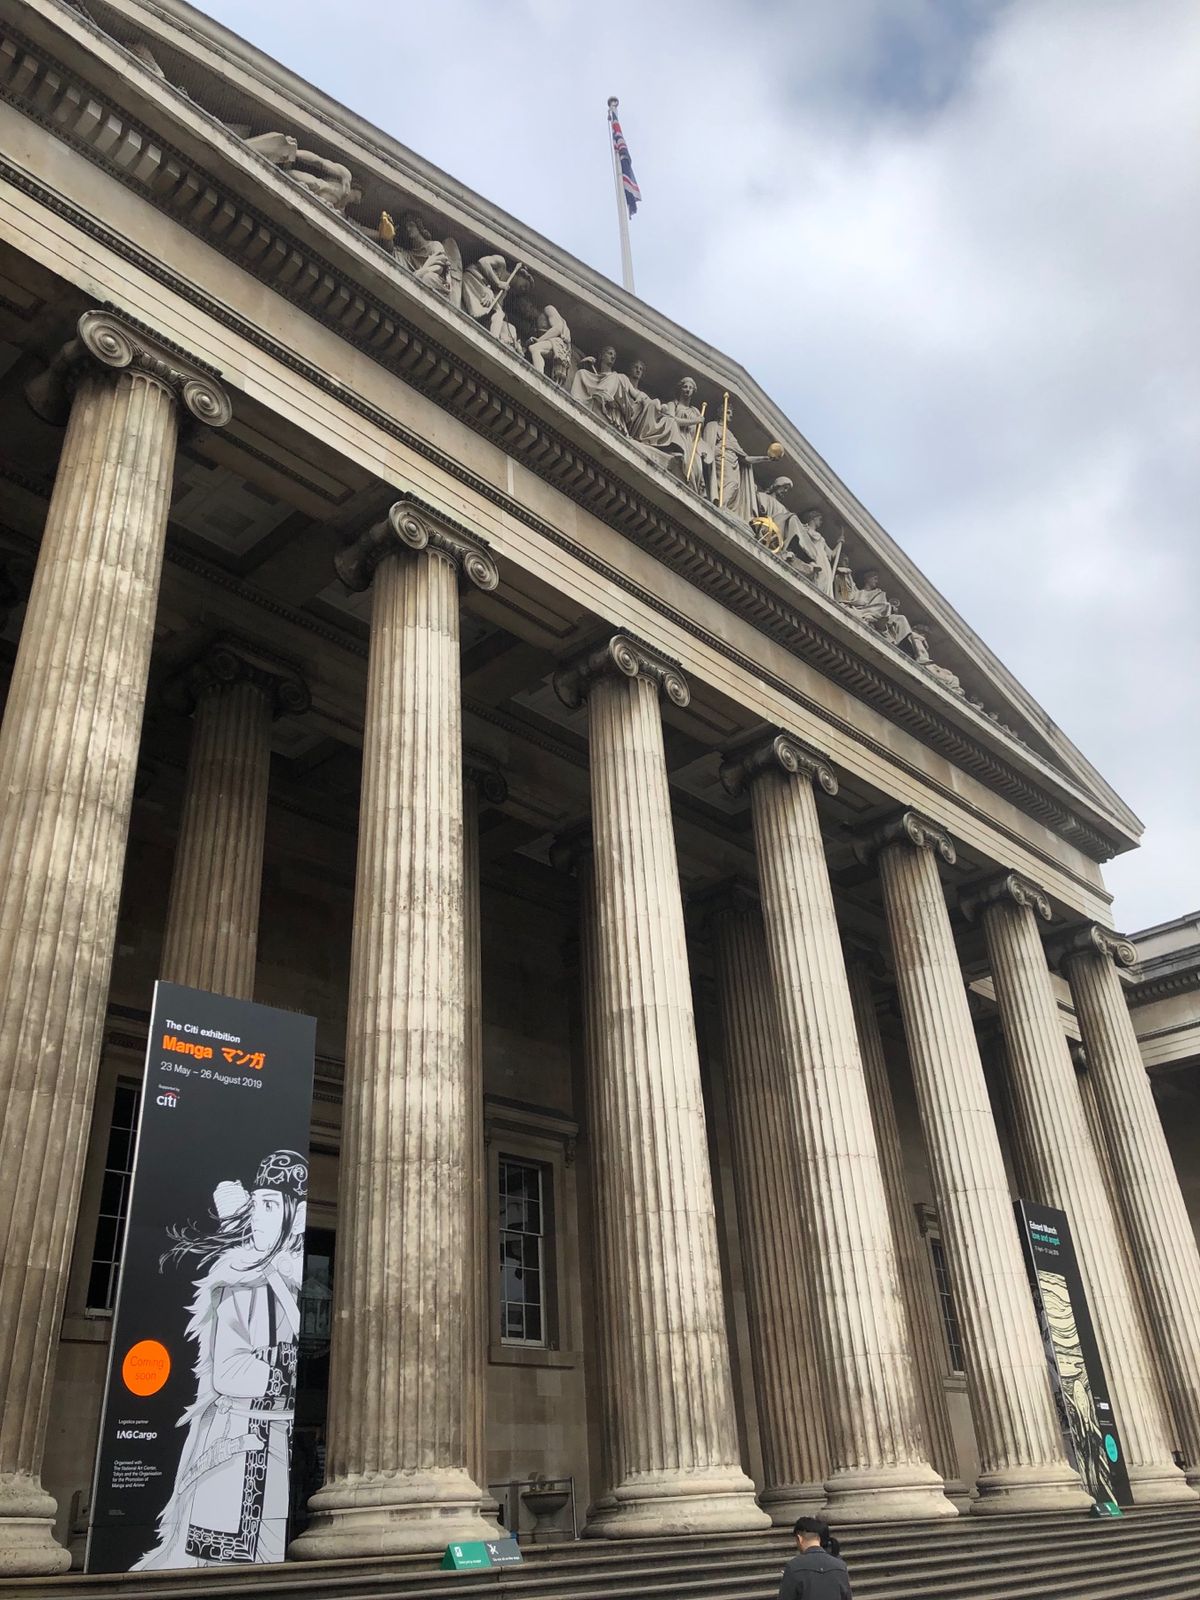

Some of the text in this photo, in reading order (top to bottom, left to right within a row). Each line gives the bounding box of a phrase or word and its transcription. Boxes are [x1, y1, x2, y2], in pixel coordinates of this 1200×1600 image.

[165, 1019, 241, 1044] The Citi exhibition
[162, 1034, 266, 1070] Manga マンガ
[160, 1061, 172, 1071] 23
[174, 1064, 191, 1077] May
[200, 1069, 212, 1079] 26
[213, 1074, 241, 1086] August
[242, 1077, 263, 1089] 2019
[130, 1355, 164, 1381] Coming soon
